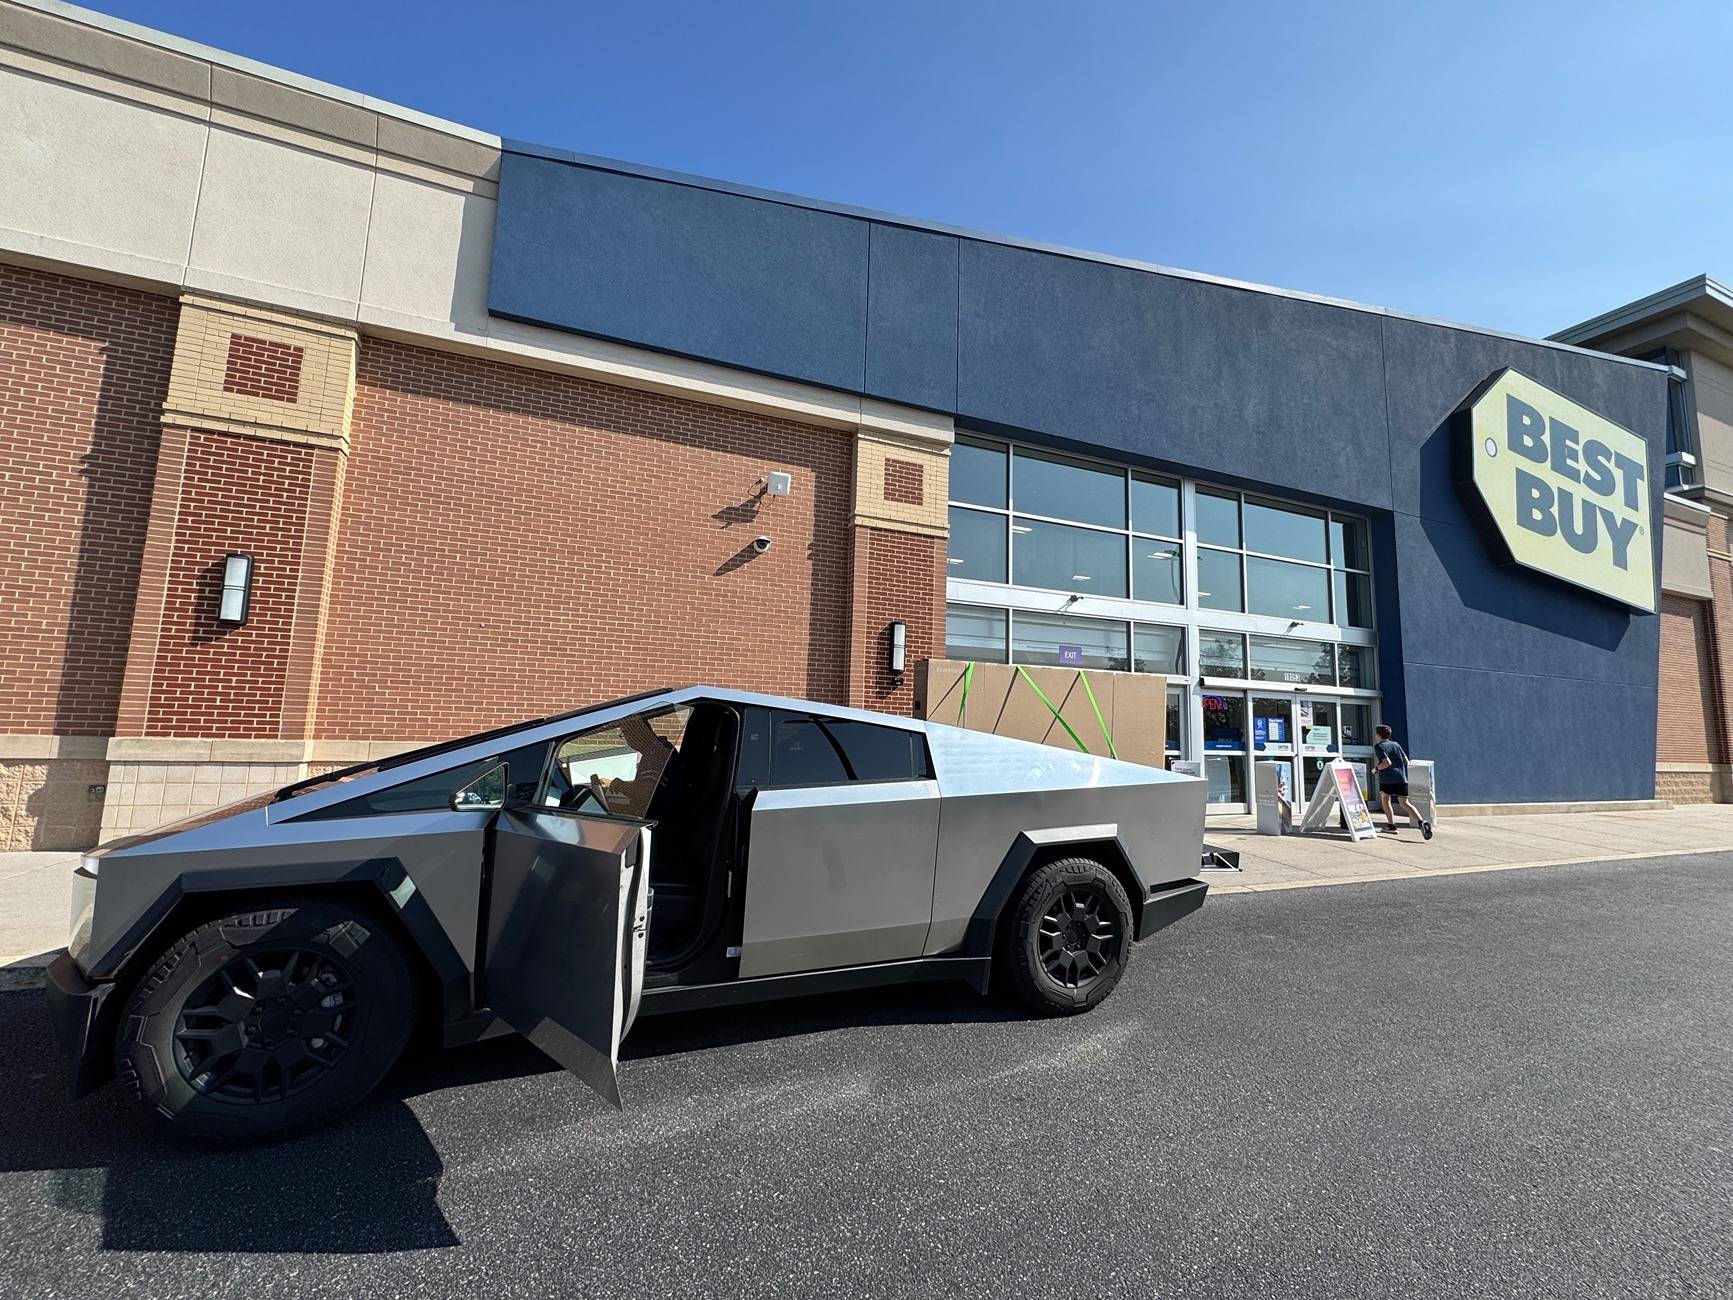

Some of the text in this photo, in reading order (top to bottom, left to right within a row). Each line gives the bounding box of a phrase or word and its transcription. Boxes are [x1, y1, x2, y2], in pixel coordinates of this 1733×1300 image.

[1506, 393, 1644, 512] BEST
[1515, 466, 1639, 571] BUY
[1064, 650, 1077, 659] EXIT
